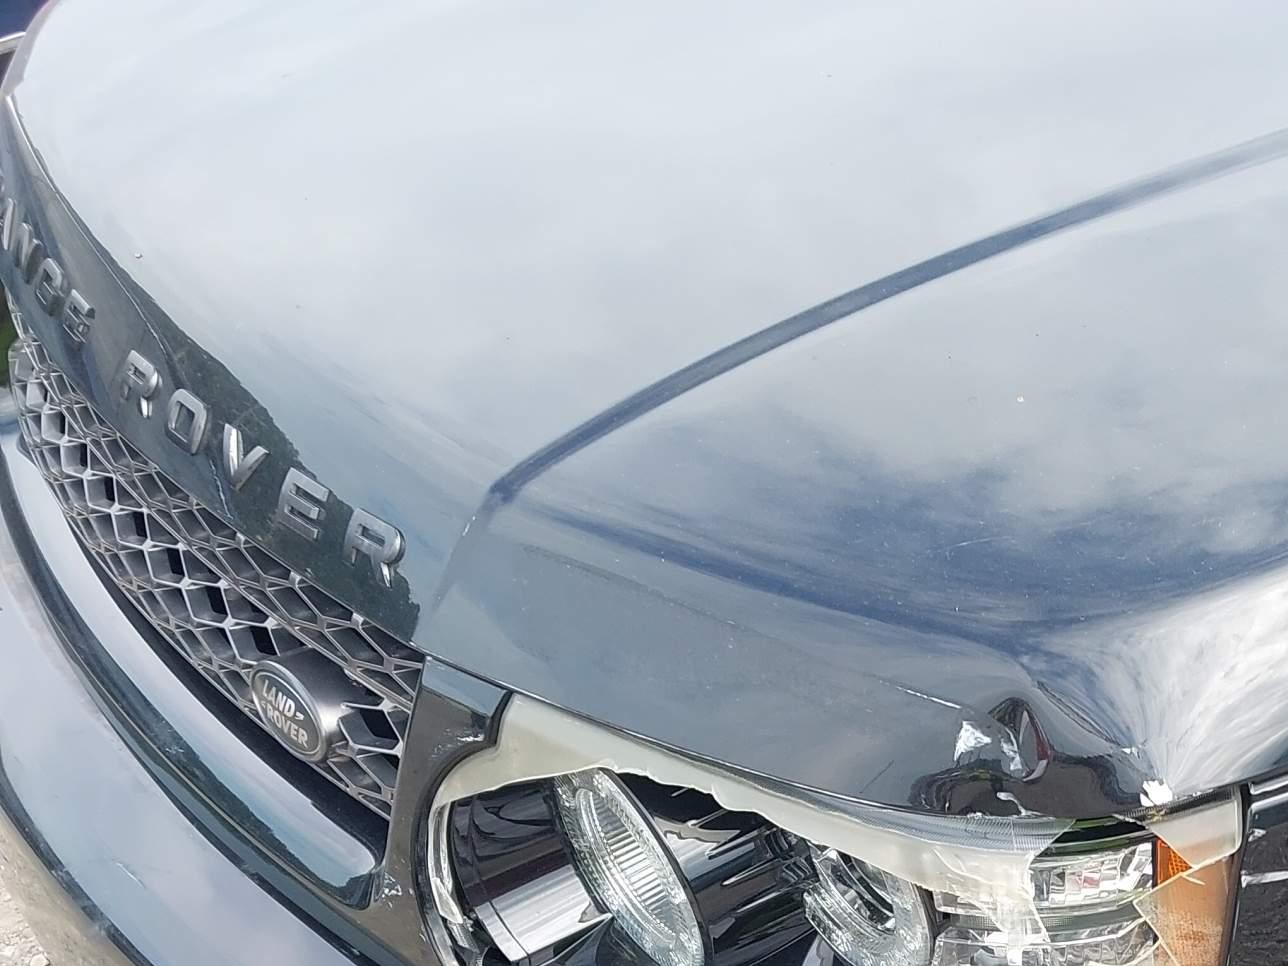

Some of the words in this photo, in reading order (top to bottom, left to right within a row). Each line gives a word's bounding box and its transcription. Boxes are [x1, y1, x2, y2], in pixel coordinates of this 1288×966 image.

[118, 349, 407, 589] ROVER
[262, 679, 296, 718] LAND
[265, 702, 309, 749] ROVER
